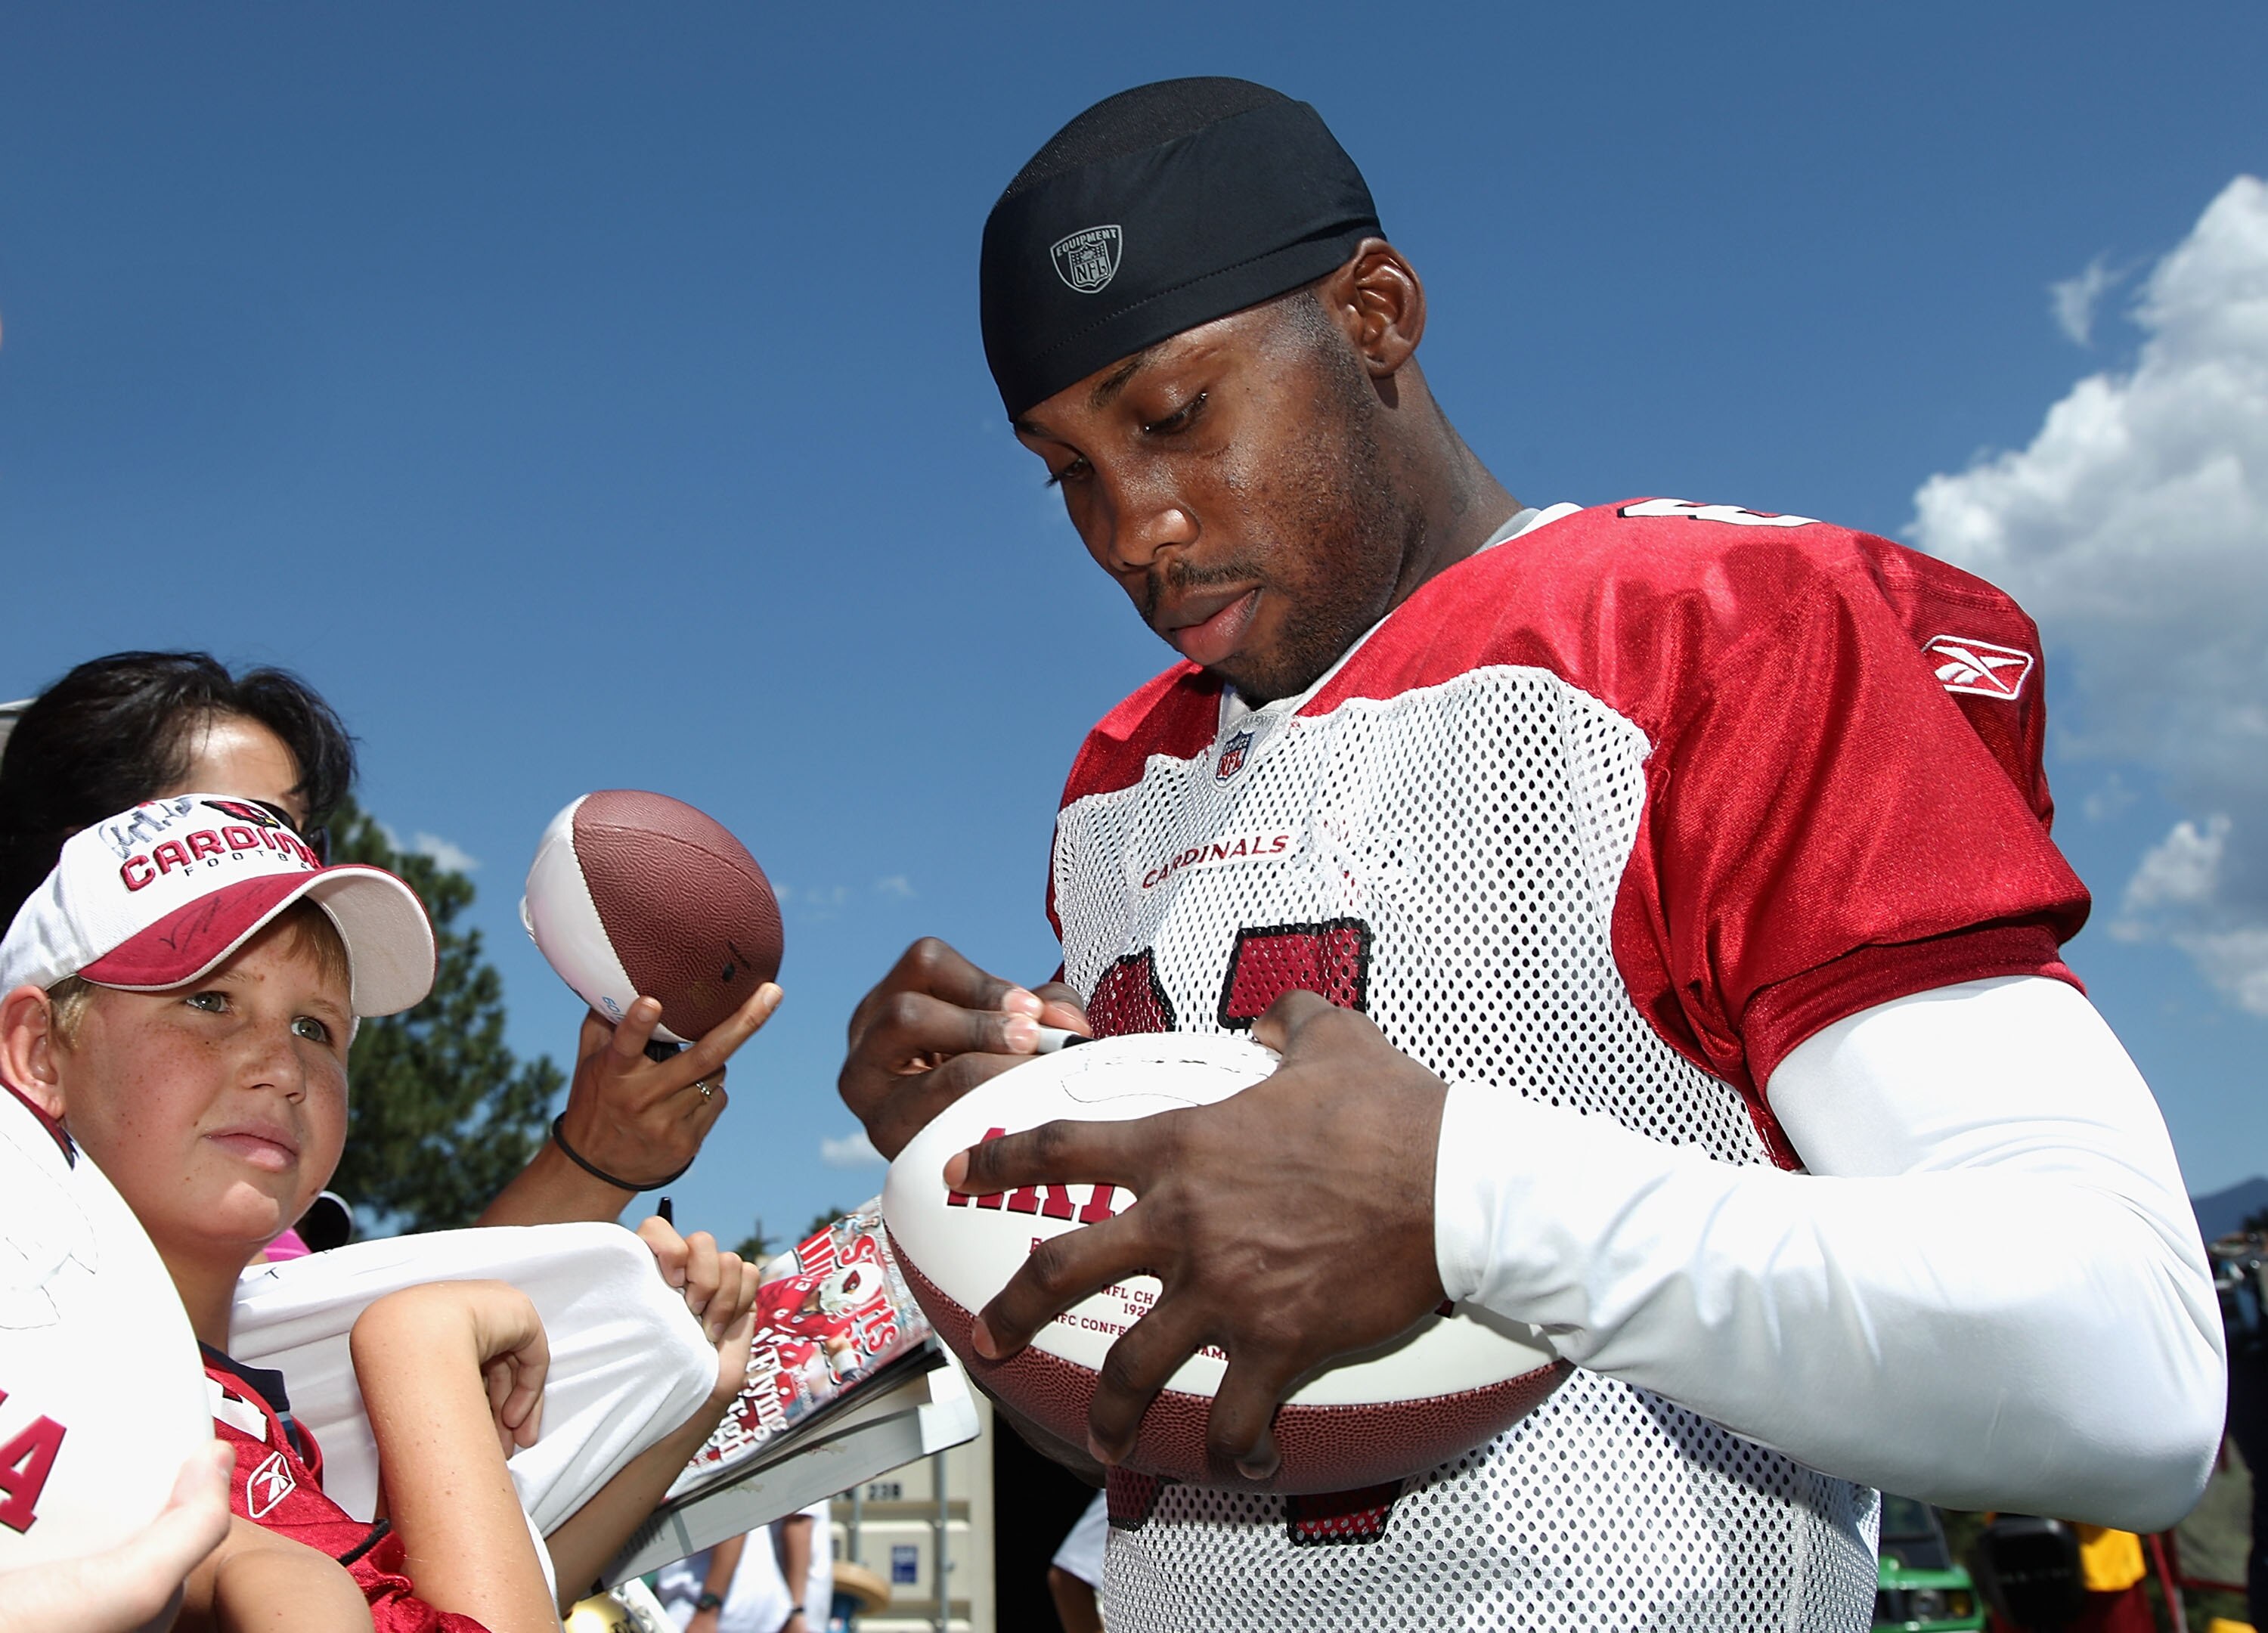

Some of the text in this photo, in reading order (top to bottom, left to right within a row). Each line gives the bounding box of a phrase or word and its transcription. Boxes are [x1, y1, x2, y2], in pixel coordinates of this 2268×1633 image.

[1056, 229, 1117, 257] EQUIPMENT
[1075, 259, 1108, 281] NFL
[120, 826, 321, 891] CARDIN
[184, 850, 310, 876] FOOTBA
[1142, 835, 1289, 888] CARDINALS
[1081, 1318, 1129, 1337] CONFE
[738, 1347, 791, 1441] Flying
